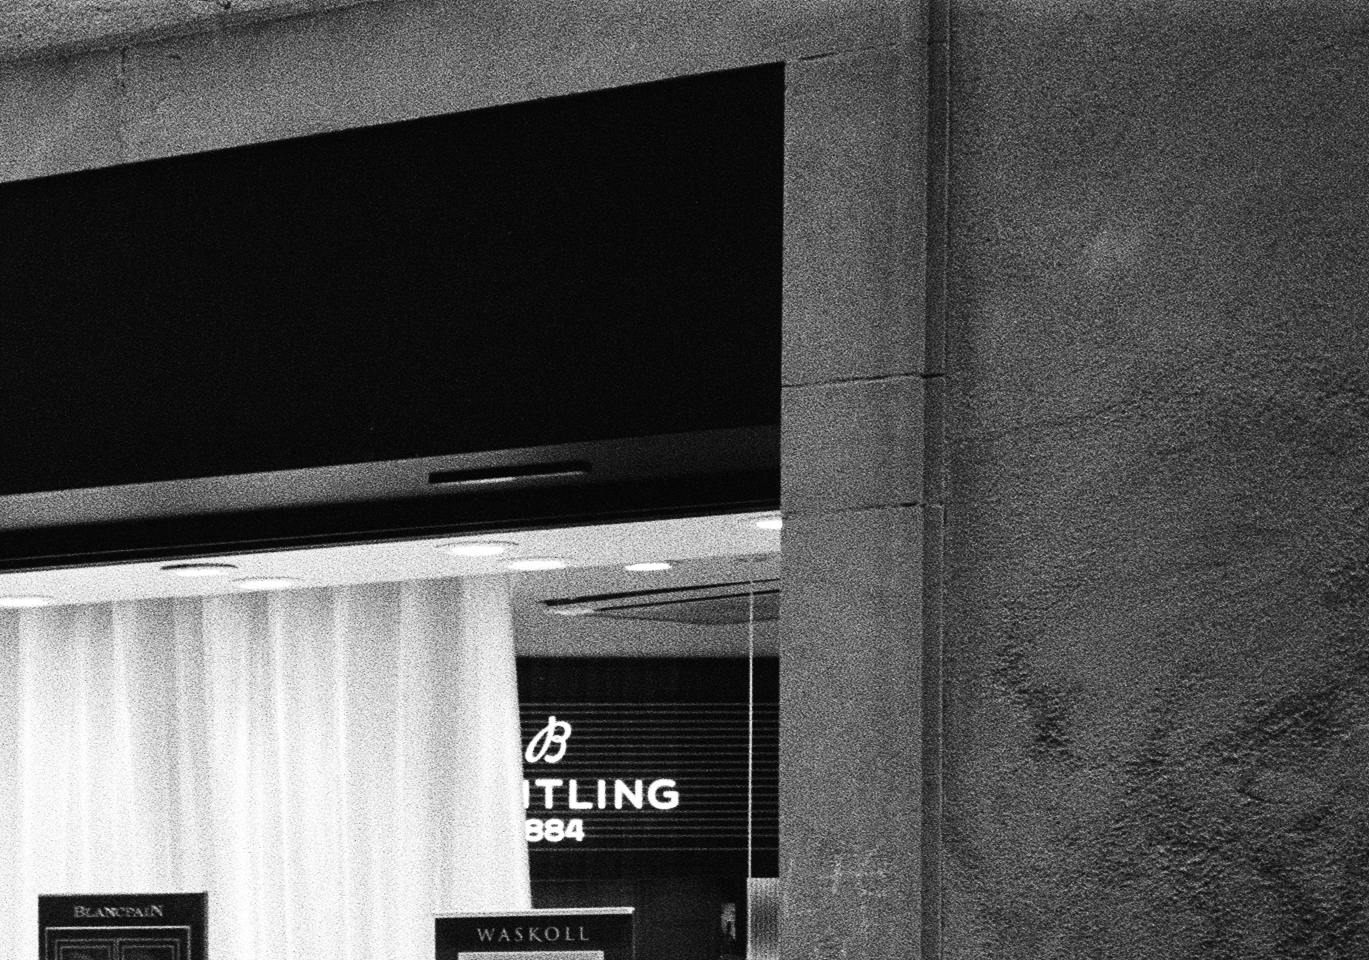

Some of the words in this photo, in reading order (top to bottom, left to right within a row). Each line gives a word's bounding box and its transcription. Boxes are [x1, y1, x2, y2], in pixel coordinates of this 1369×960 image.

[524, 818, 586, 843] 884
[73, 905, 164, 918] BLANCPAIN
[476, 926, 591, 942] WASKOLL
